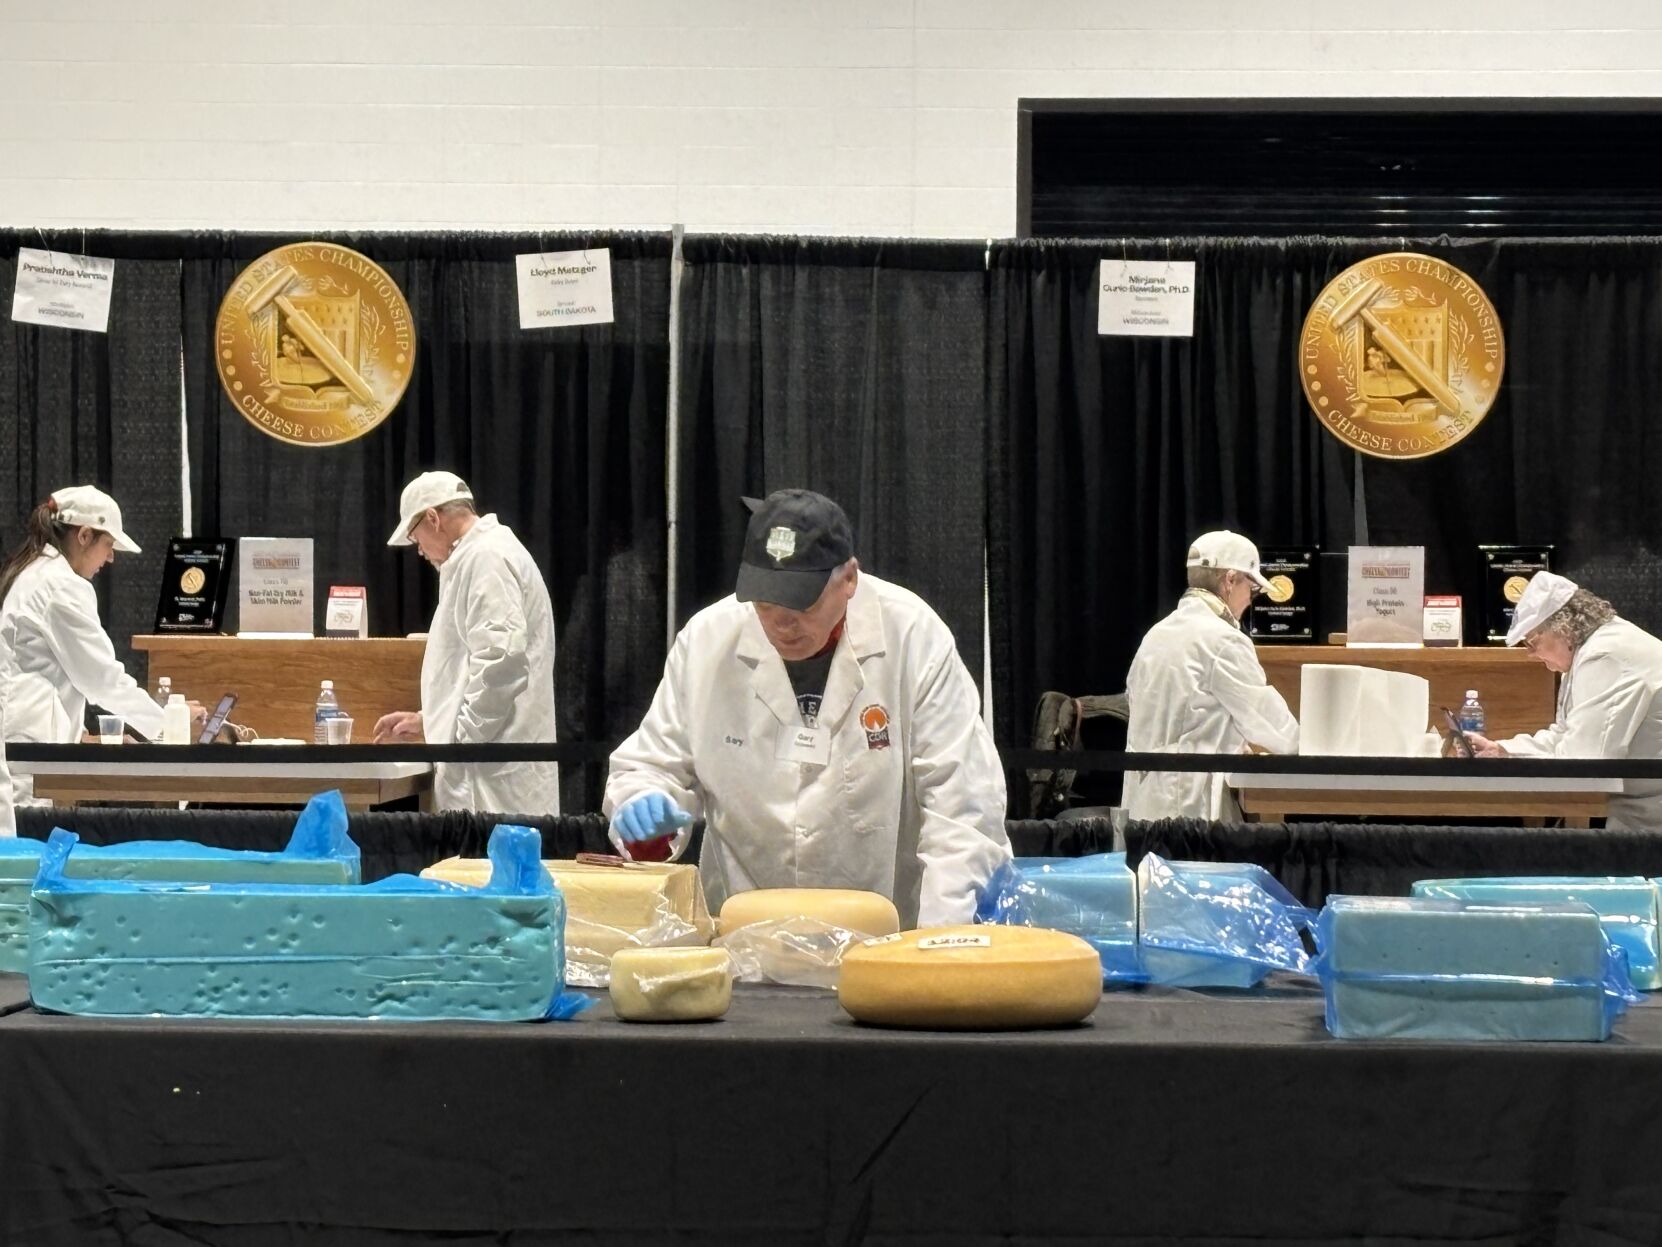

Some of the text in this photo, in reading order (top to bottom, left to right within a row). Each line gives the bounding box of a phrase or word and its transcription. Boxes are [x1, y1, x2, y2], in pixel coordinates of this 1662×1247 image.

[530, 267, 556, 277] Lloyd
[220, 248, 410, 351] UNITED STATES CHAMPIONSHIP
[536, 306, 597, 317] SOUTH DAKOTA
[1305, 258, 1499, 360] UNITED STATES CHAMPIONSHIP
[241, 394, 305, 438] CHEESE
[1327, 409, 1393, 452] CHEESE
